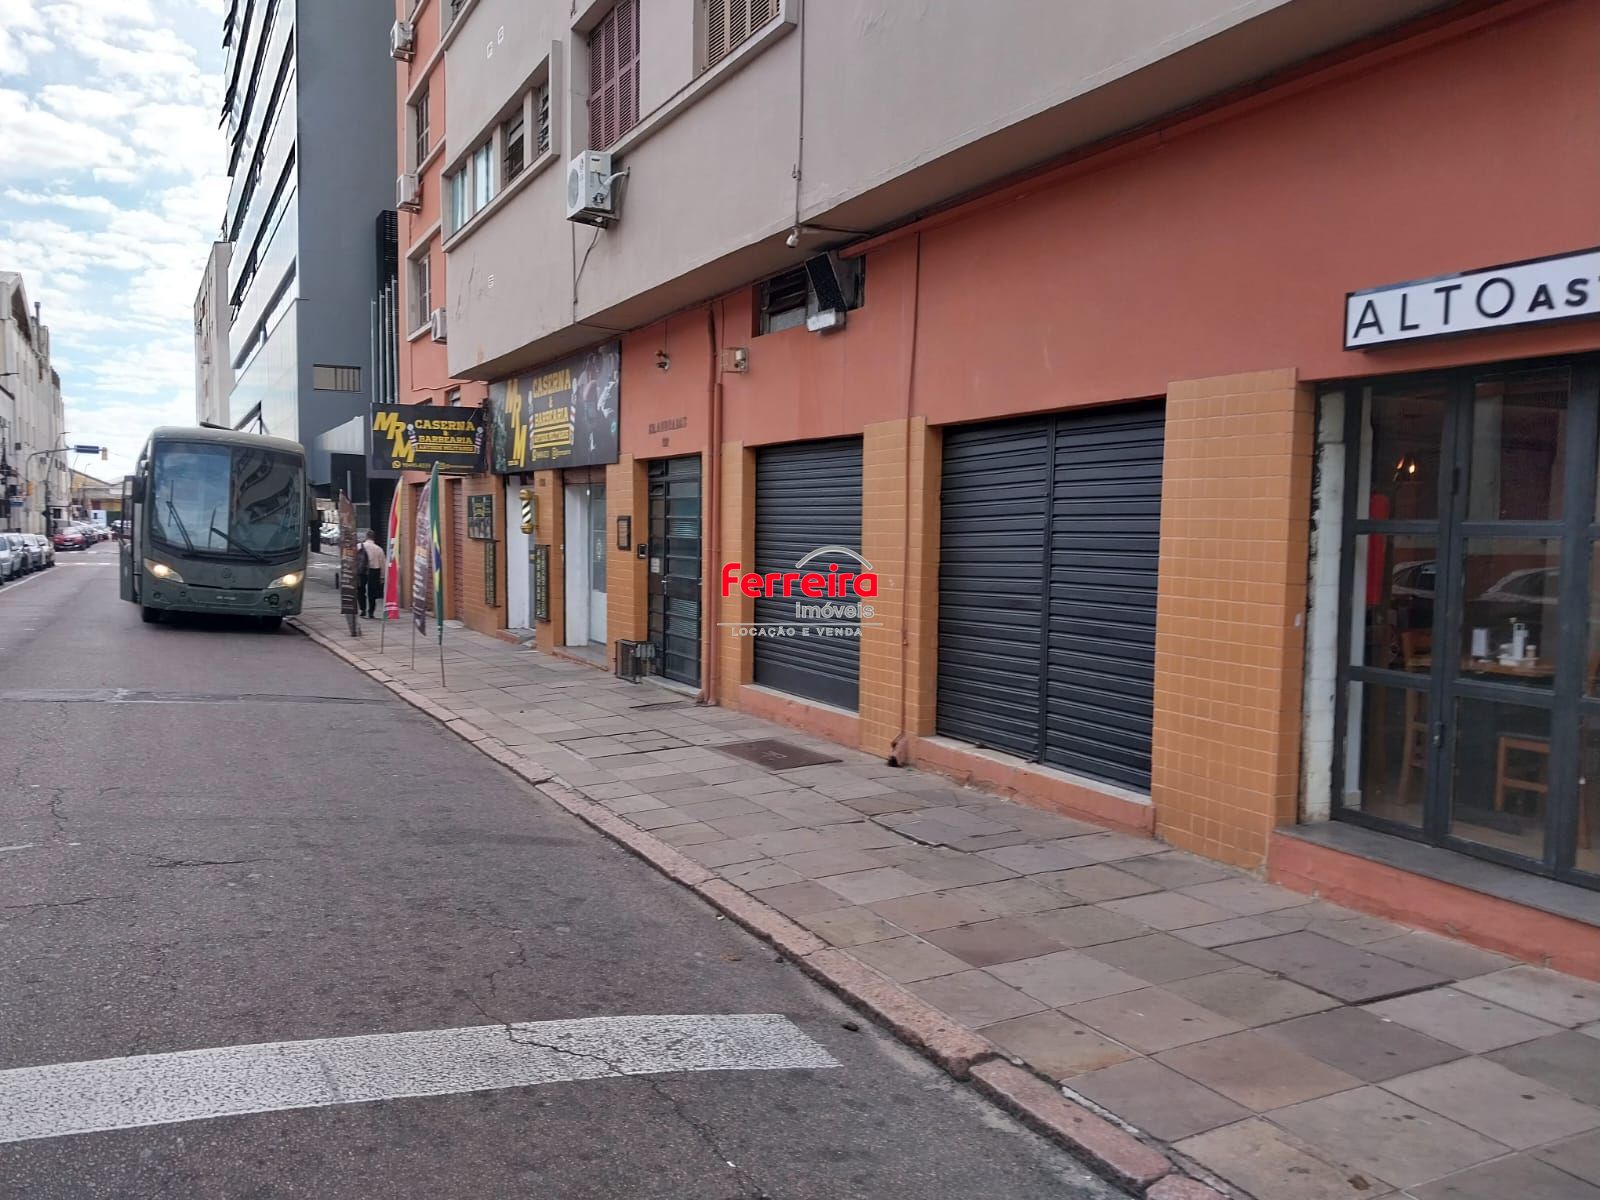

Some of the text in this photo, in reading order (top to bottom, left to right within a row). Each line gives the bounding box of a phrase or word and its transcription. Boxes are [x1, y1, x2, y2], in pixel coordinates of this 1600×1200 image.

[532, 368, 572, 399] CASERNA
[415, 419, 476, 431] CASERNA
[534, 406, 569, 428] BARBEARIA
[418, 435, 473, 444] BARBEARIA
